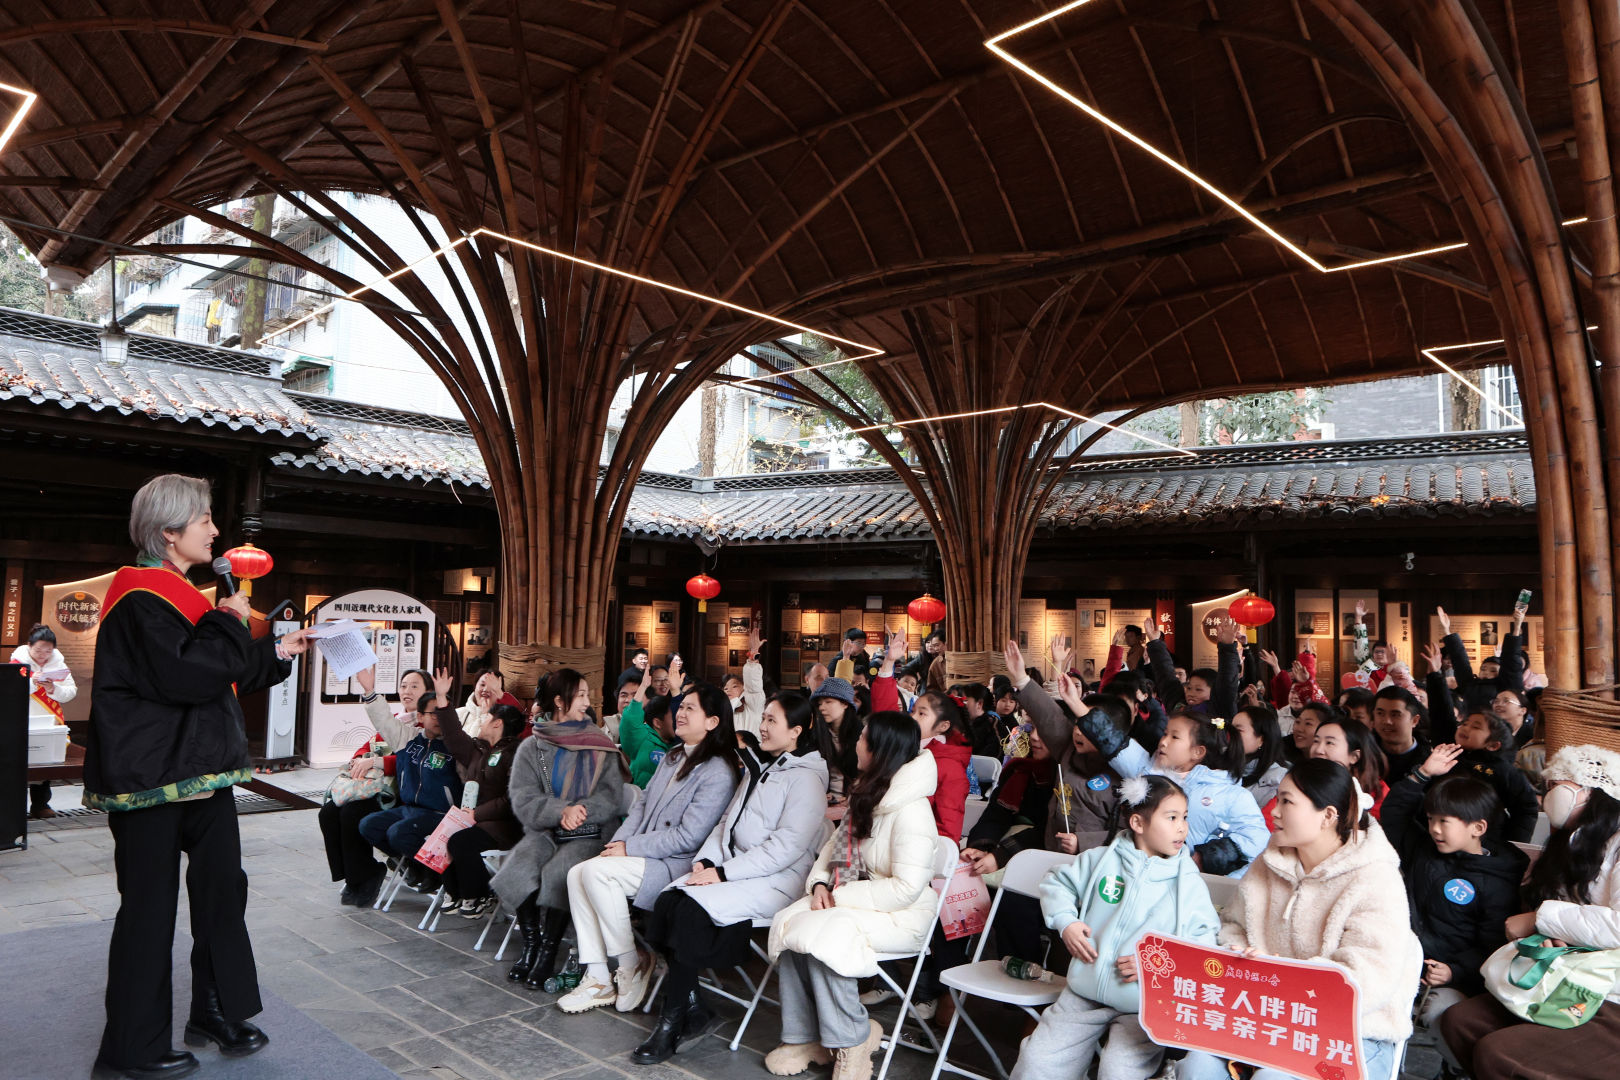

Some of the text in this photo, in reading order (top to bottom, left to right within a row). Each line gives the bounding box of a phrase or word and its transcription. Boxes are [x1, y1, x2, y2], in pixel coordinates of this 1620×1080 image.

[58, 601, 100, 611] 时代新家
[334, 603, 422, 615] 四川近现代文化名人家风
[1090, 777, 1104, 789] A2
[1102, 884, 1121, 900] B2
[1447, 886, 1467, 902] A3
[1173, 975, 1318, 1027] 娘家人伴你
[1175, 1002, 1354, 1066] 乐享亲子时光
